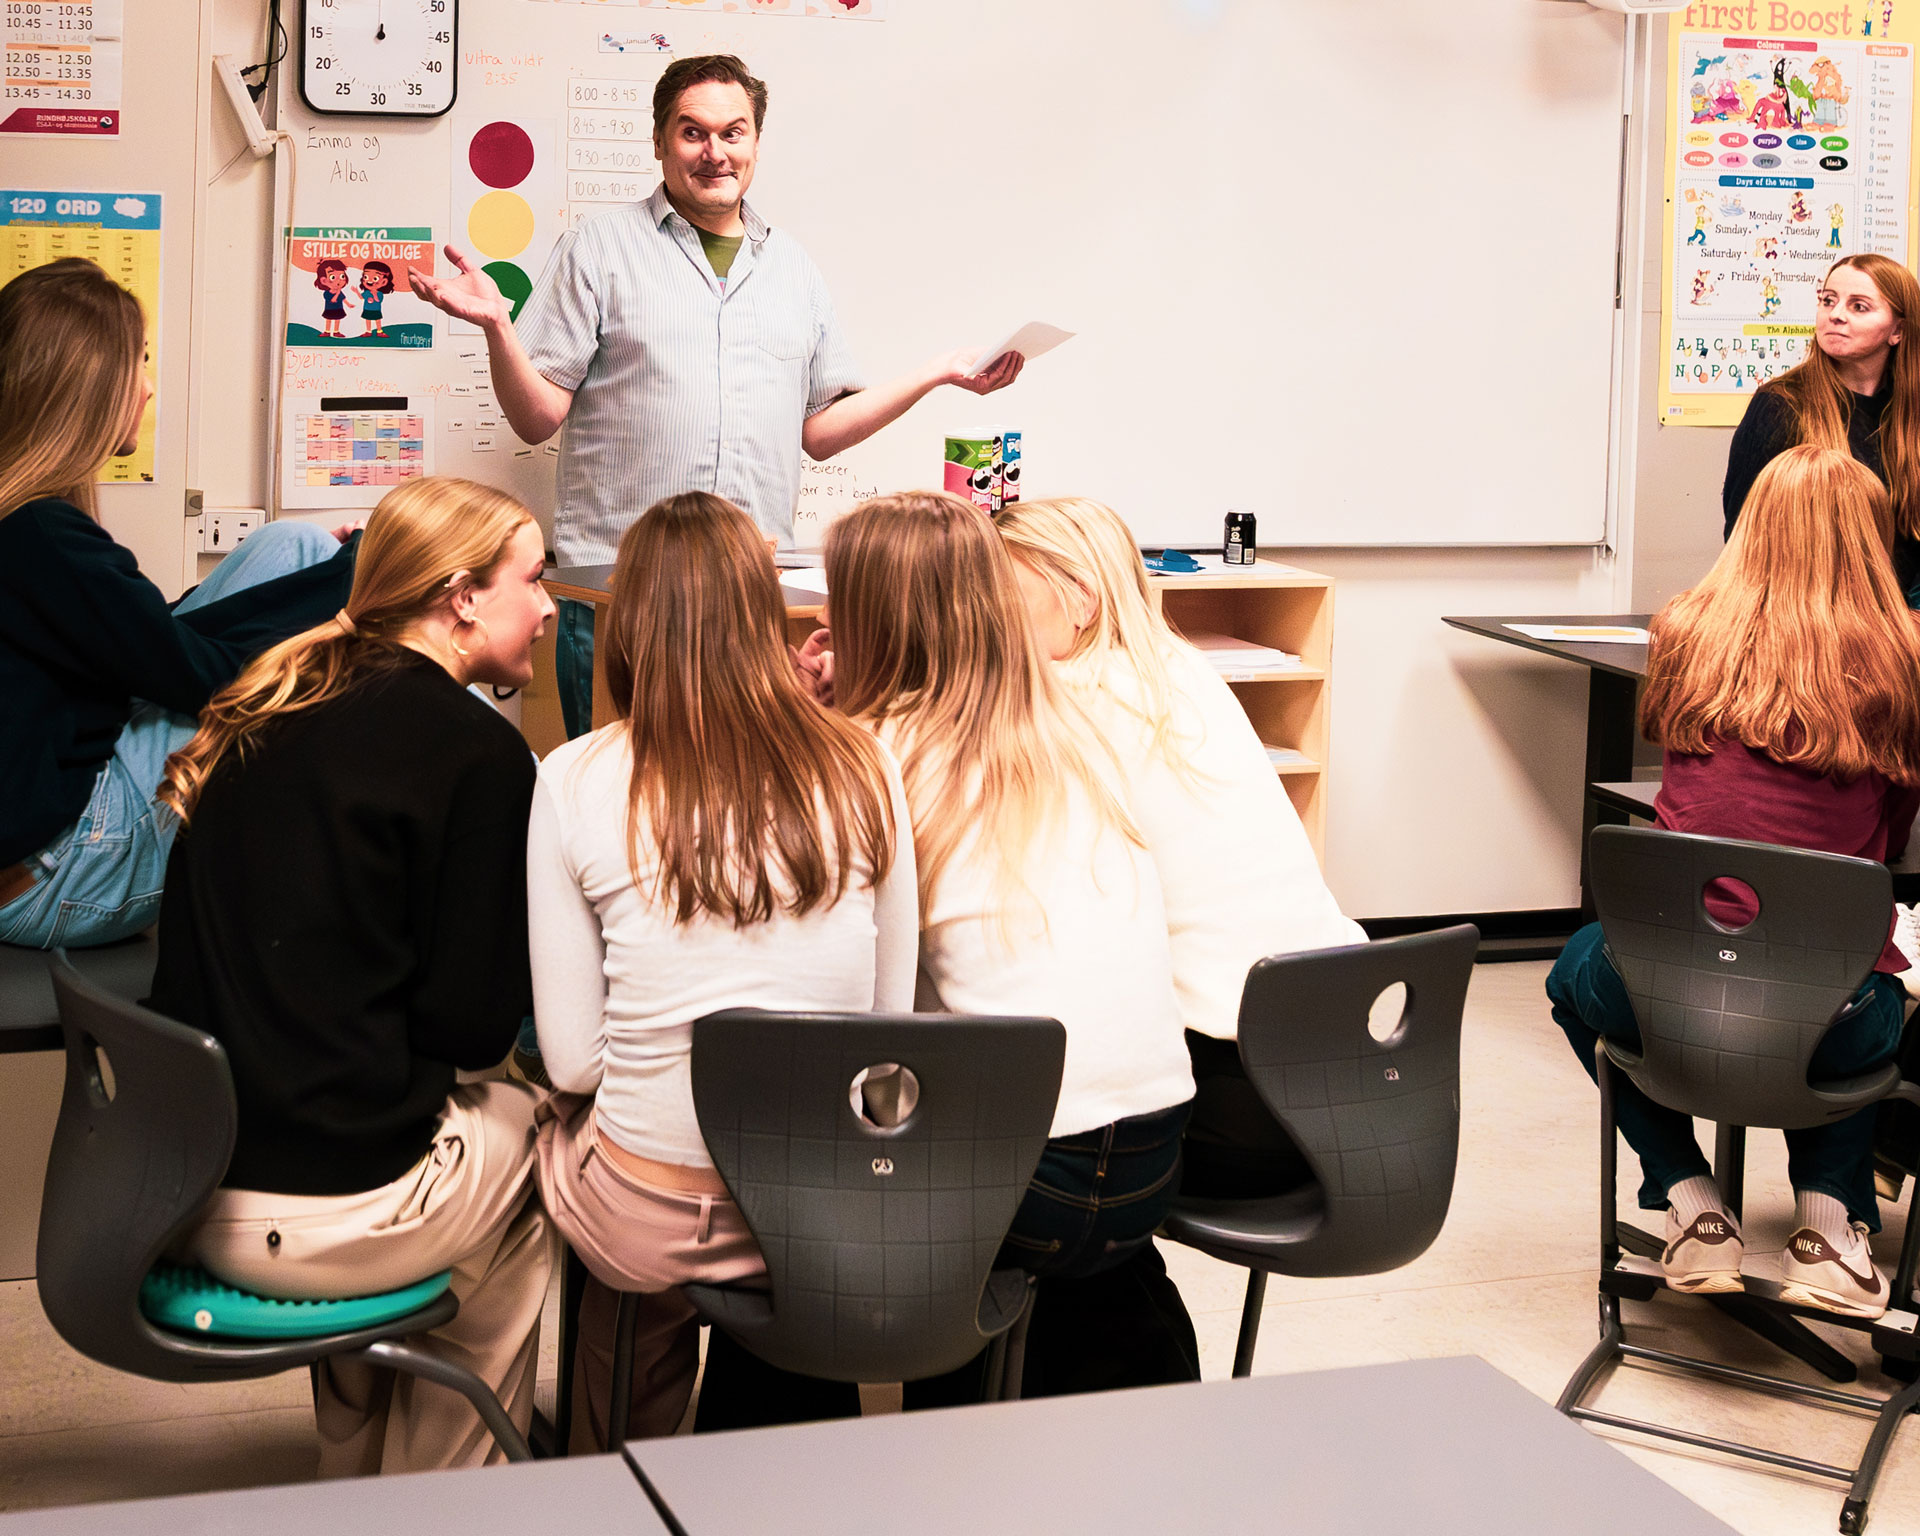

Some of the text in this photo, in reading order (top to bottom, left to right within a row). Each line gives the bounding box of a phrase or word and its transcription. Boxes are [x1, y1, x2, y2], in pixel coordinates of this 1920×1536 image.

[7, 4, 41, 14] 10.00
[59, 6, 93, 16] 10.45
[430, 0, 445, 13] 50
[7, 18, 41, 28] 10.45
[59, 20, 93, 30] 11.30
[1768, 2, 1852, 36] Boost
[310, 26, 323, 39] 15
[435, 32, 450, 44] 45
[1756, 41, 1785, 50] Colours
[5, 53, 41, 64] 12.05
[58, 55, 92, 65] 12.50
[315, 57, 331, 70] 20
[5, 67, 41, 77] 12.50
[58, 69, 92, 79] 13.35
[426, 61, 442, 73] 40
[5, 88, 40, 98] 13.45
[56, 89, 91, 100] 14.30
[335, 83, 351, 95] 25
[407, 84, 423, 96] 35
[370, 93, 386, 105] 30
[307, 126, 381, 161] Emma og
[1690, 134, 1710, 143] yellow
[1728, 136, 1740, 144] red
[1757, 137, 1777, 147] purple
[1825, 140, 1843, 148] green
[1689, 156, 1710, 164] orange
[1726, 156, 1740, 164] pink
[1759, 158, 1774, 166] grey
[1825, 159, 1842, 167] black
[330, 160, 368, 183] Alba
[1736, 177, 1798, 188] Days of the Week
[9, 197, 101, 216] 120 ORD
[1748, 211, 1783, 223] Monday
[1715, 224, 1748, 236] Sunday
[1784, 226, 1820, 237] Tuesday
[303, 241, 422, 260] STILLE OG ROLIGE
[1700, 248, 1741, 260] Saturday
[1789, 250, 1837, 261] Wednesday
[1731, 271, 1760, 282] Friday
[1774, 272, 1816, 283] Thursday
[1767, 326, 1780, 334] The
[1676, 338, 1686, 351] A
[1696, 338, 1705, 350] B
[1714, 338, 1723, 351] C
[1733, 338, 1742, 351] D
[1751, 338, 1760, 351] E
[1769, 339, 1778, 351] F
[1786, 339, 1795, 351] G
[1675, 364, 1686, 377] N
[1693, 364, 1703, 377] O
[1711, 364, 1720, 377] P
[1728, 364, 1738, 377] Q
[1747, 364, 1756, 377] R
[1764, 364, 1773, 377] S
[800, 460, 848, 476] fleverer
[1696, 1222, 1725, 1236] NIKE
[1795, 1237, 1823, 1257] NIKE
